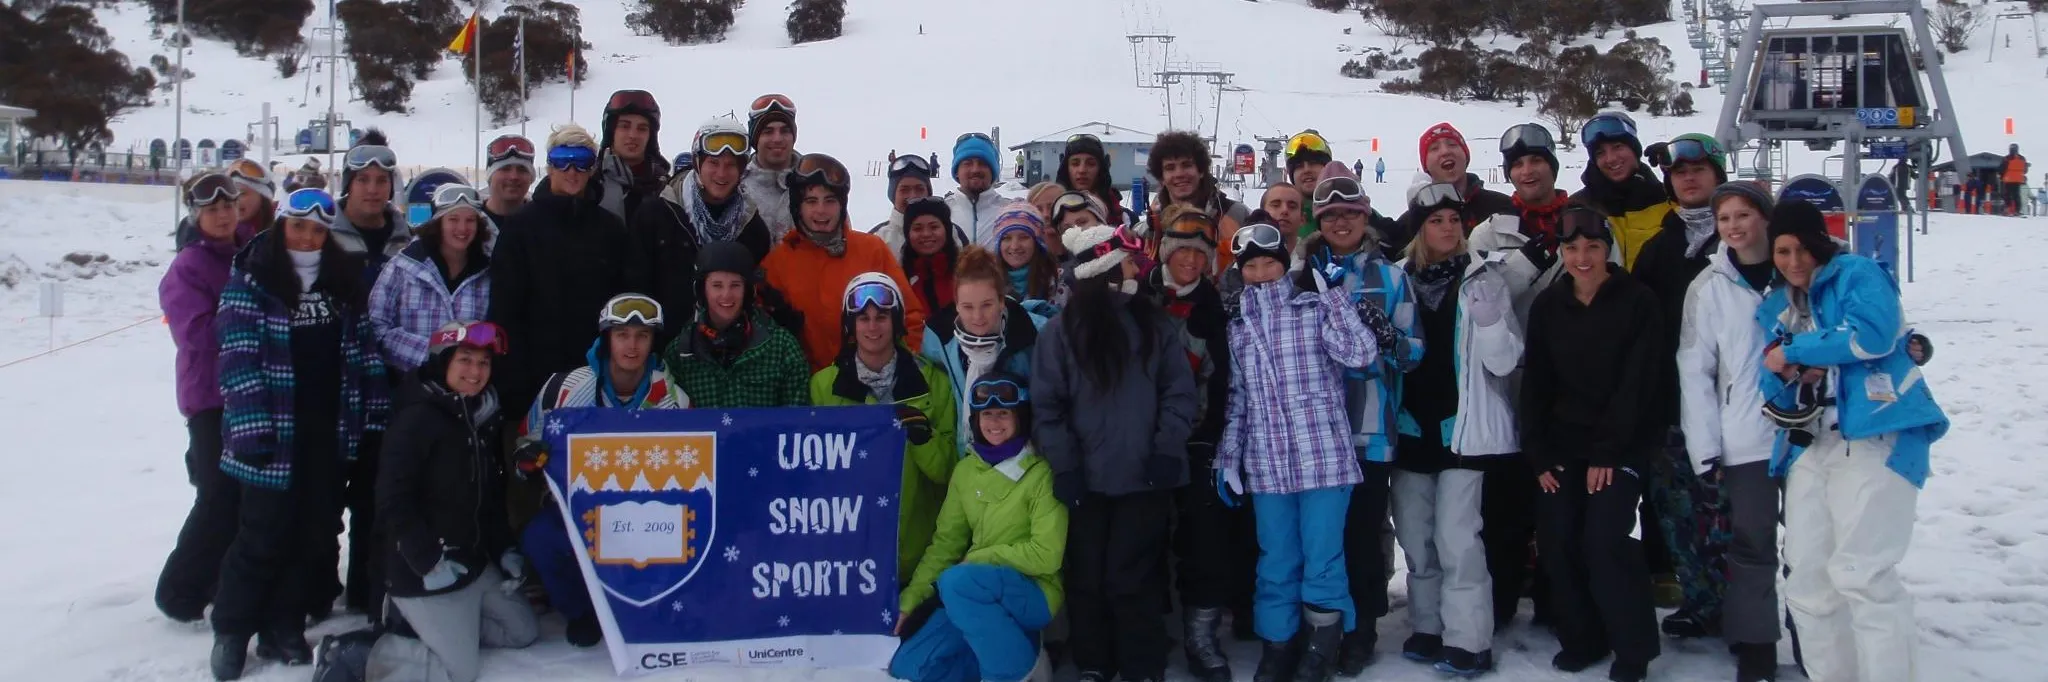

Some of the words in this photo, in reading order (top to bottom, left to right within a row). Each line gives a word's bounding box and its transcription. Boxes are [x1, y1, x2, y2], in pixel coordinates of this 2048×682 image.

[778, 432, 856, 471] UOW
[768, 495, 863, 535] SNOW
[612, 519, 635, 533] Est.
[644, 521, 675, 534] 2009
[641, 652, 688, 670] CSE
[748, 648, 804, 659] UniCentre
